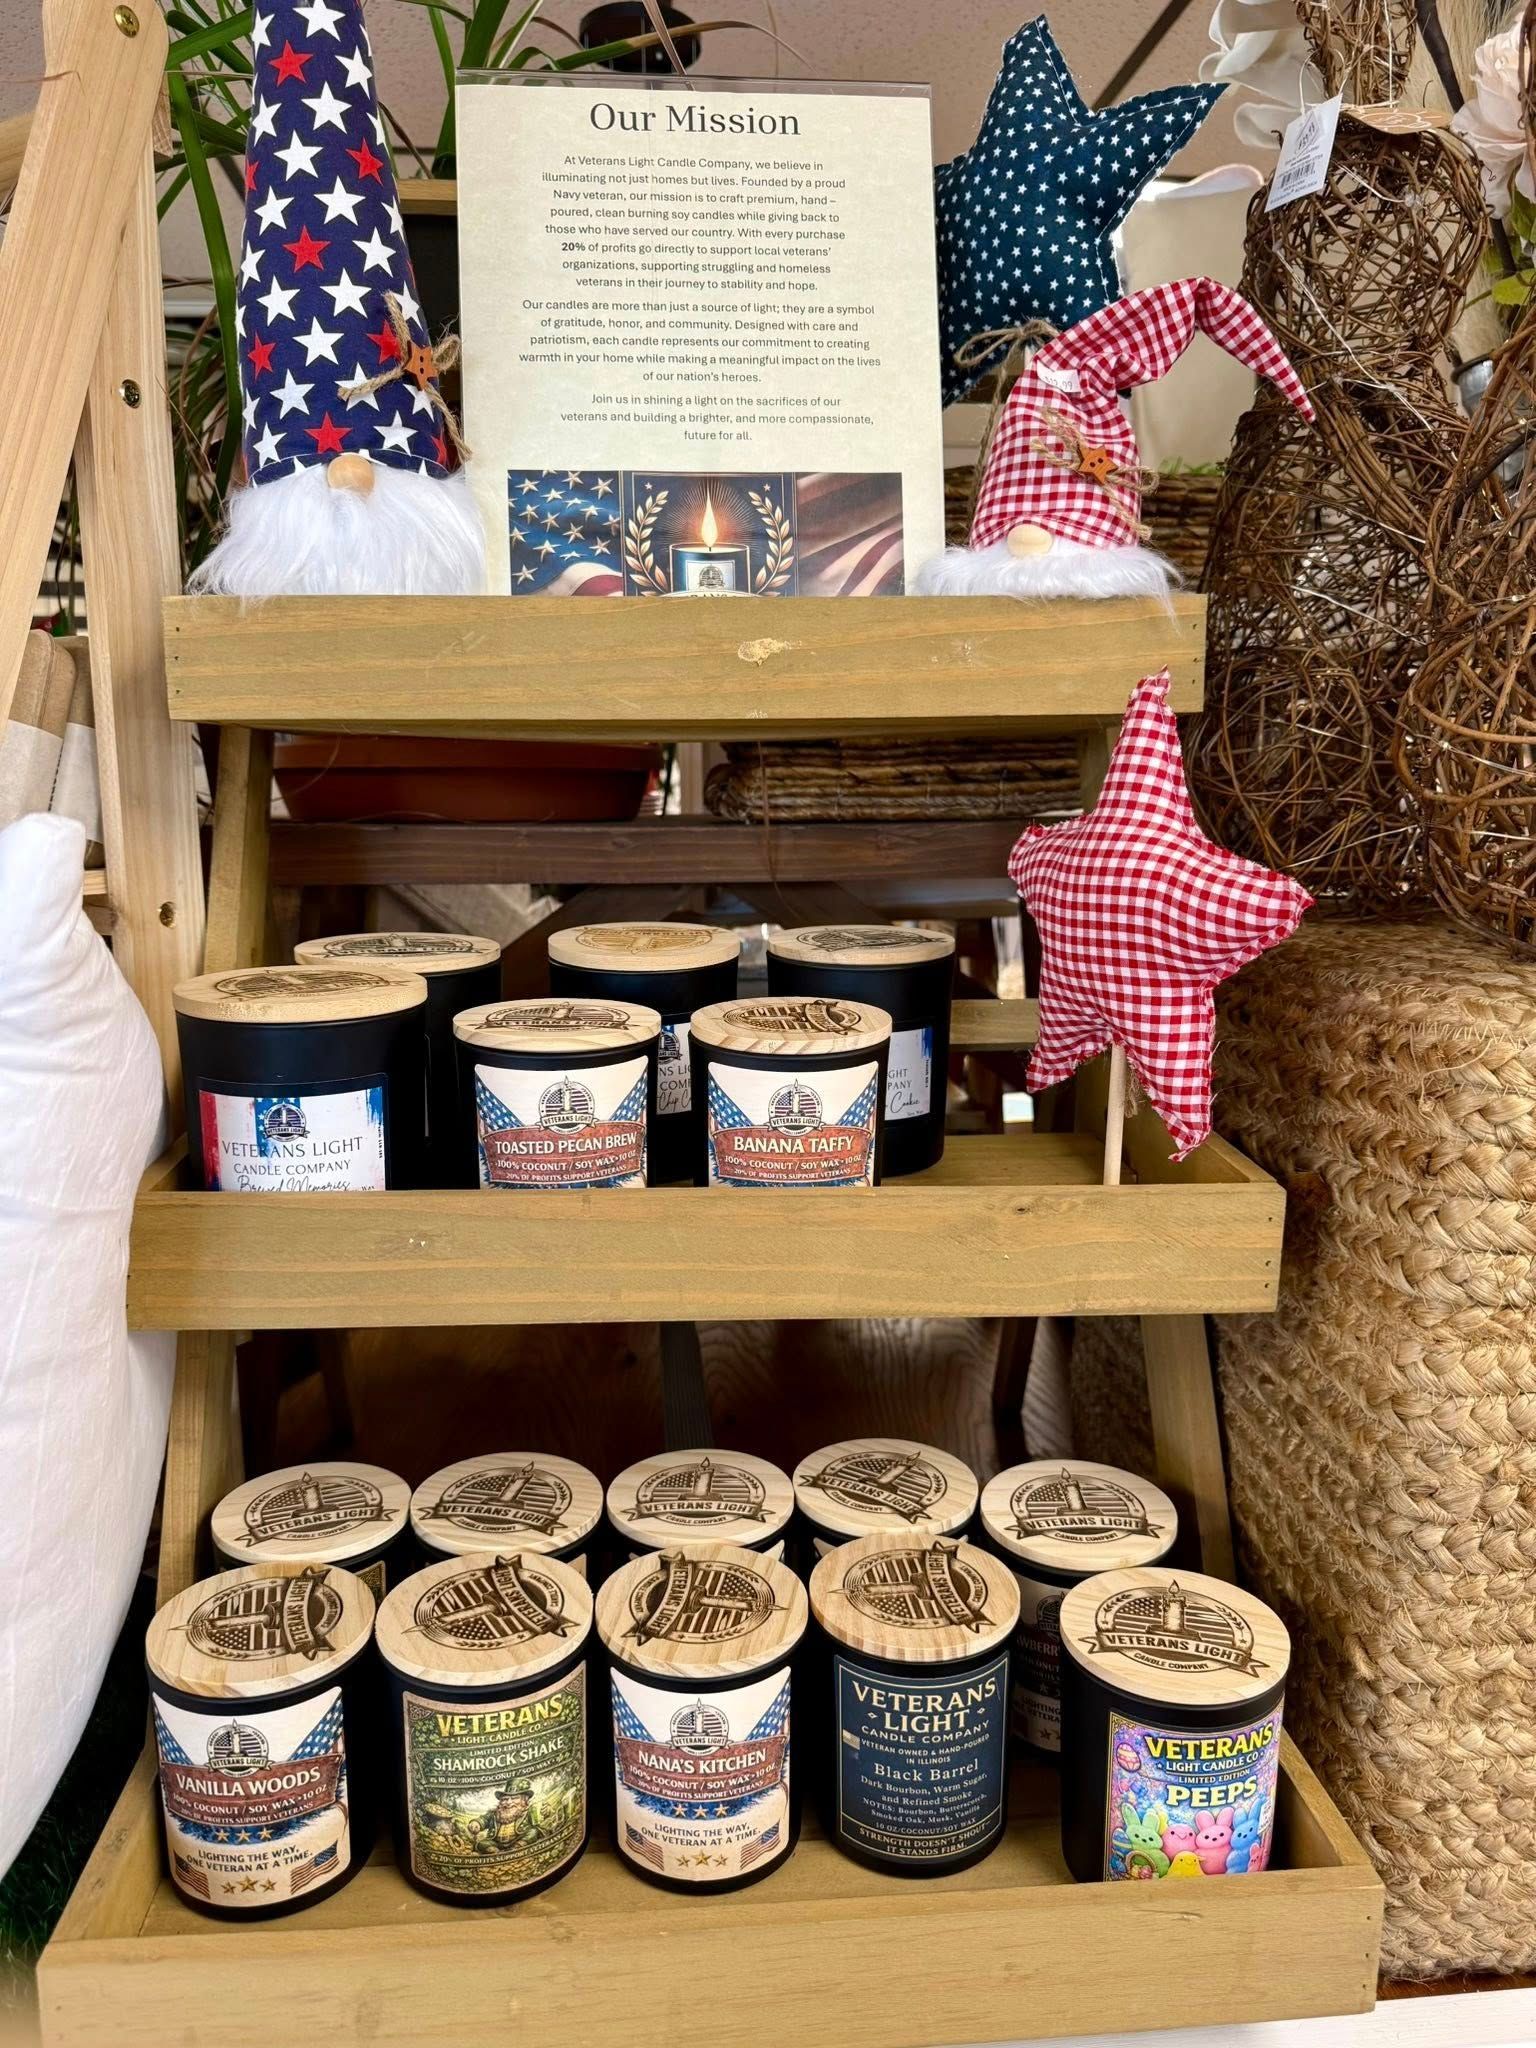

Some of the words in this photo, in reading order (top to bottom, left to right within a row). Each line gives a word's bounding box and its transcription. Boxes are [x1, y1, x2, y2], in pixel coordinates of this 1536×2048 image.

[590, 103, 656, 131] Our
[665, 105, 801, 135] Mission
[564, 155, 576, 164] At
[578, 156, 626, 165] Veterans
[629, 157, 654, 168] Light
[657, 158, 696, 167] Candle
[699, 159, 752, 170] Company,
[774, 160, 811, 170] believe
[814, 161, 823, 170] in
[542, 172, 606, 185] illuminating
[608, 174, 626, 183] not
[628, 174, 649, 185] just
[651, 174, 688, 184] homes
[691, 176, 708, 185] but
[711, 176, 738, 186] lives.
[742, 177, 788, 187] Founded
[791, 178, 803, 189] by
[815, 179, 845, 189] proud
[553, 190, 581, 201] Navy
[582, 192, 626, 201] veteran,
[650, 192, 692, 202] mission
[695, 192, 704, 202] is
[706, 193, 716, 202] to
[720, 194, 744, 203] craft
[747, 194, 798, 206] premium,
[801, 196, 827, 205] hand
[550, 207, 592, 218] poured,
[595, 208, 625, 217] clean
[628, 209, 669, 221] burning
[672, 211, 690, 221] soy
[692, 210, 734, 220] candles
[737, 211, 765, 221] while
[768, 212, 798, 224] giving
[801, 212, 826, 222] back
[829, 214, 839, 222] to
[545, 224, 576, 234] those
[578, 225, 602, 234] who
[604, 225, 630, 235] have
[632, 226, 668, 236] served
[692, 228, 734, 239] country.
[737, 228, 762, 238] With
[765, 231, 793, 240] every
[796, 230, 845, 241] purchase
[561, 242, 586, 251] 20%
[588, 242, 598, 252] of
[602, 243, 636, 254] profits
[639, 245, 652, 255] go
[654, 244, 694, 256] directly
[697, 246, 708, 254] to
[710, 246, 752, 256] support
[754, 246, 780, 256] local
[782, 247, 831, 256] veterans'
[562, 259, 638, 271] organizations,
[641, 261, 699, 273] supporting
[702, 262, 754, 274] struggling
[756, 264, 776, 273] and
[779, 264, 831, 274] homeless
[576, 278, 622, 287] veterans
[626, 277, 635, 287] in
[638, 278, 663, 288] their
[664, 278, 705, 290] journey
[707, 280, 718, 289] to
[721, 279, 763, 291] stability
[766, 281, 785, 290] and
[788, 281, 817, 292] hope.
[222, 1141, 305, 1158] VETERANS
[313, 1137, 363, 1156] LIGHT
[495, 1141, 554, 1154] TOASTED
[559, 1139, 602, 1152] PECAN
[606, 1132, 637, 1148] BREW
[734, 1137, 805, 1153] BANANA
[809, 1136, 854, 1152] TAFFY
[234, 1164, 281, 1175] CANDLE
[286, 1160, 350, 1175] COMPANY
[822, 1476, 884, 1497] VETERANS
[885, 1493, 919, 1514] LIGHT
[442, 1505, 510, 1516] VETERANS
[513, 1512, 551, 1524] LIGHT
[644, 1502, 713, 1512] VETERANS
[717, 1502, 755, 1513] LIGHT
[258, 1513, 332, 1534] VETERANS
[336, 1509, 378, 1519] LIGHT
[1027, 1517, 1096, 1528] VETERANS
[1102, 1518, 1143, 1528] LIGHT
[1105, 1634, 1191, 1650] VETERANS
[1195, 1642, 1245, 1662] LIGHT
[1133, 1652, 1166, 1667] CANDLE
[1168, 1662, 1209, 1670] COMPANY
[852, 1677, 996, 1713] VETERANS
[436, 1694, 563, 1737] VETERANS
[884, 1709, 969, 1733] LIGHT
[490, 1729, 527, 1742] CANDLE
[861, 1726, 915, 1743] CANDLE
[922, 1720, 989, 1743] COMPANY
[1144, 1722, 1273, 1760] VETERANS
[433, 1754, 517, 1771] SHAMROCK
[520, 1736, 564, 1761] SHAKE
[470, 1746, 501, 1756] LIMITED
[504, 1740, 534, 1752] EDITION
[861, 1738, 896, 1754] VETERAN
[939, 1733, 990, 1755] HAND-POURED
[639, 1751, 694, 1774] NANA'S
[700, 1749, 766, 1774] KITCHEN
[874, 1762, 922, 1781] Black
[930, 1758, 978, 1781] Barrel
[918, 1756, 951, 1764] ILLINOIS
[1166, 1762, 1201, 1772] LIGHT
[1202, 1754, 1244, 1771] CANDLE
[176, 1773, 245, 1796] VANILLA
[248, 1767, 320, 1794] WOODS
[630, 1765, 650, 1780] 100%
[653, 1775, 698, 1790] COCONUT
[707, 1781, 726, 1789] SOY
[729, 1775, 750, 1786] WAX
[861, 1775, 883, 1789] Dark
[886, 1784, 931, 1796] Bourbon,
[934, 1784, 961, 1794] Warm
[1180, 1776, 1215, 1784] LIMITED
[1218, 1769, 1250, 1781] EDITION
[882, 1795, 899, 1803] and
[943, 1791, 972, 1803] Smoke
[1166, 1775, 1257, 1807] PEEPS
[641, 1827, 660, 1839] ONE
[662, 1835, 707, 1846] VETERAN
[735, 1828, 760, 1840] TIME.
[655, 1823, 700, 1837] LIGHTING
